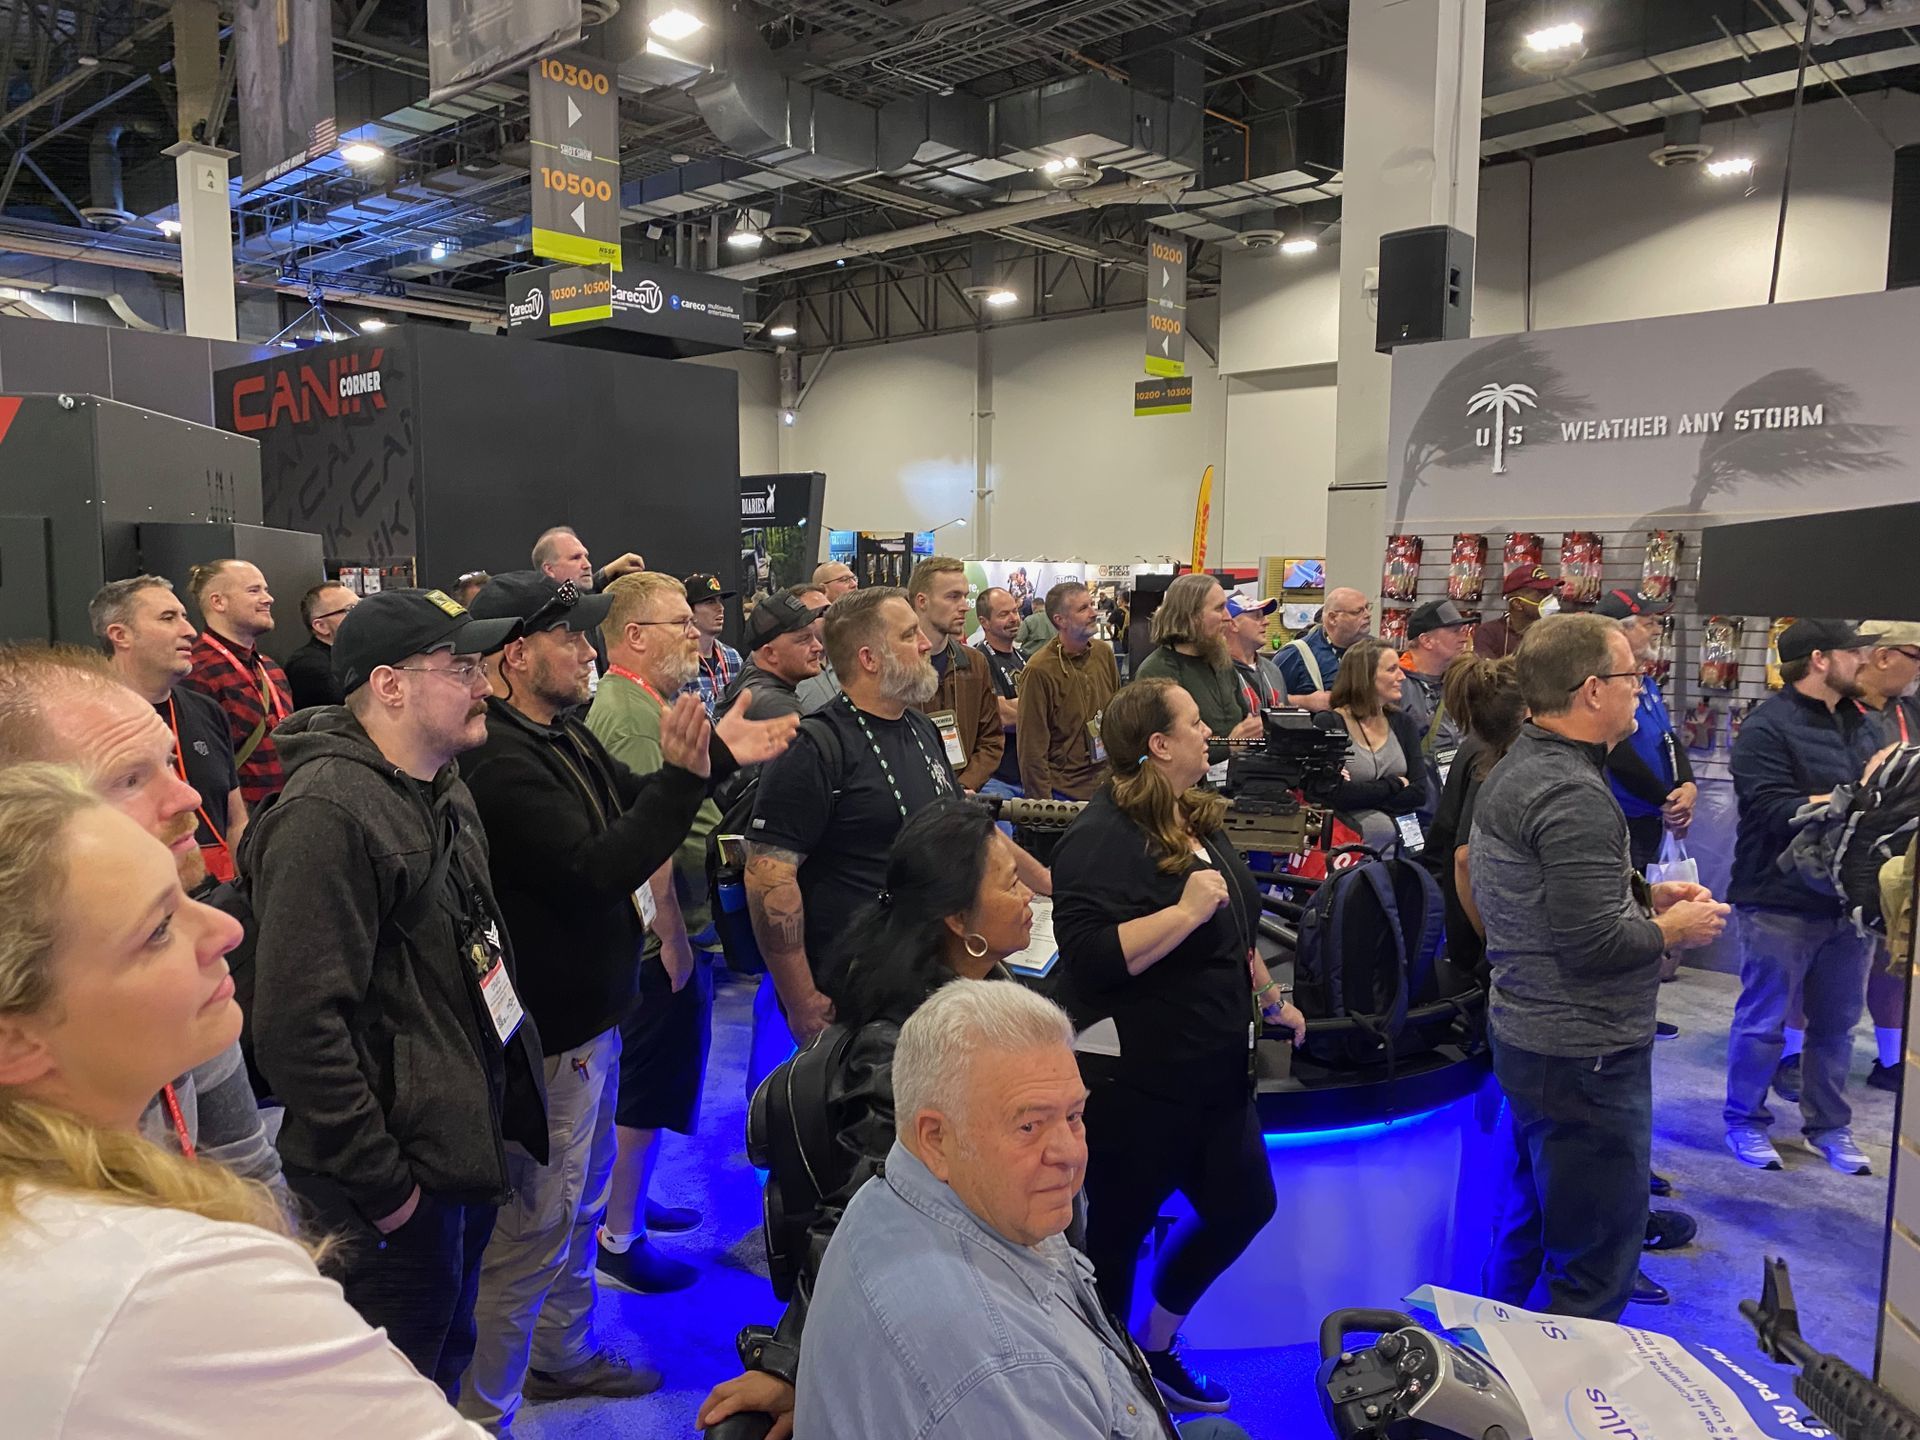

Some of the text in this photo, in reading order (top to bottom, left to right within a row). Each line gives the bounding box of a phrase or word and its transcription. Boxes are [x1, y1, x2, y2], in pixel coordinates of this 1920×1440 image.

[540, 58, 609, 95] 10300
[206, 169, 215, 179] A
[207, 181, 214, 189] 4
[540, 167, 612, 202] 10500
[598, 247, 616, 255] NSSF
[1151, 243, 1183, 265] 10200
[551, 287, 577, 300] 10300
[583, 280, 610, 295] 10500
[681, 299, 706, 311] careco
[707, 303, 734, 313] multimedia
[1150, 314, 1181, 335] 10300
[339, 370, 381, 398] CORNER
[1136, 389, 1160, 400] 10200
[1166, 386, 1192, 398] 10300
[1561, 403, 1823, 442] WEATHER ANY STORM
[1656, 1351, 1693, 1383] Analytics
[1649, 1360, 1693, 1402] eCommerce
[1695, 1389, 1727, 1424] Loyalty
[1697, 1411, 1718, 1434] Sale
